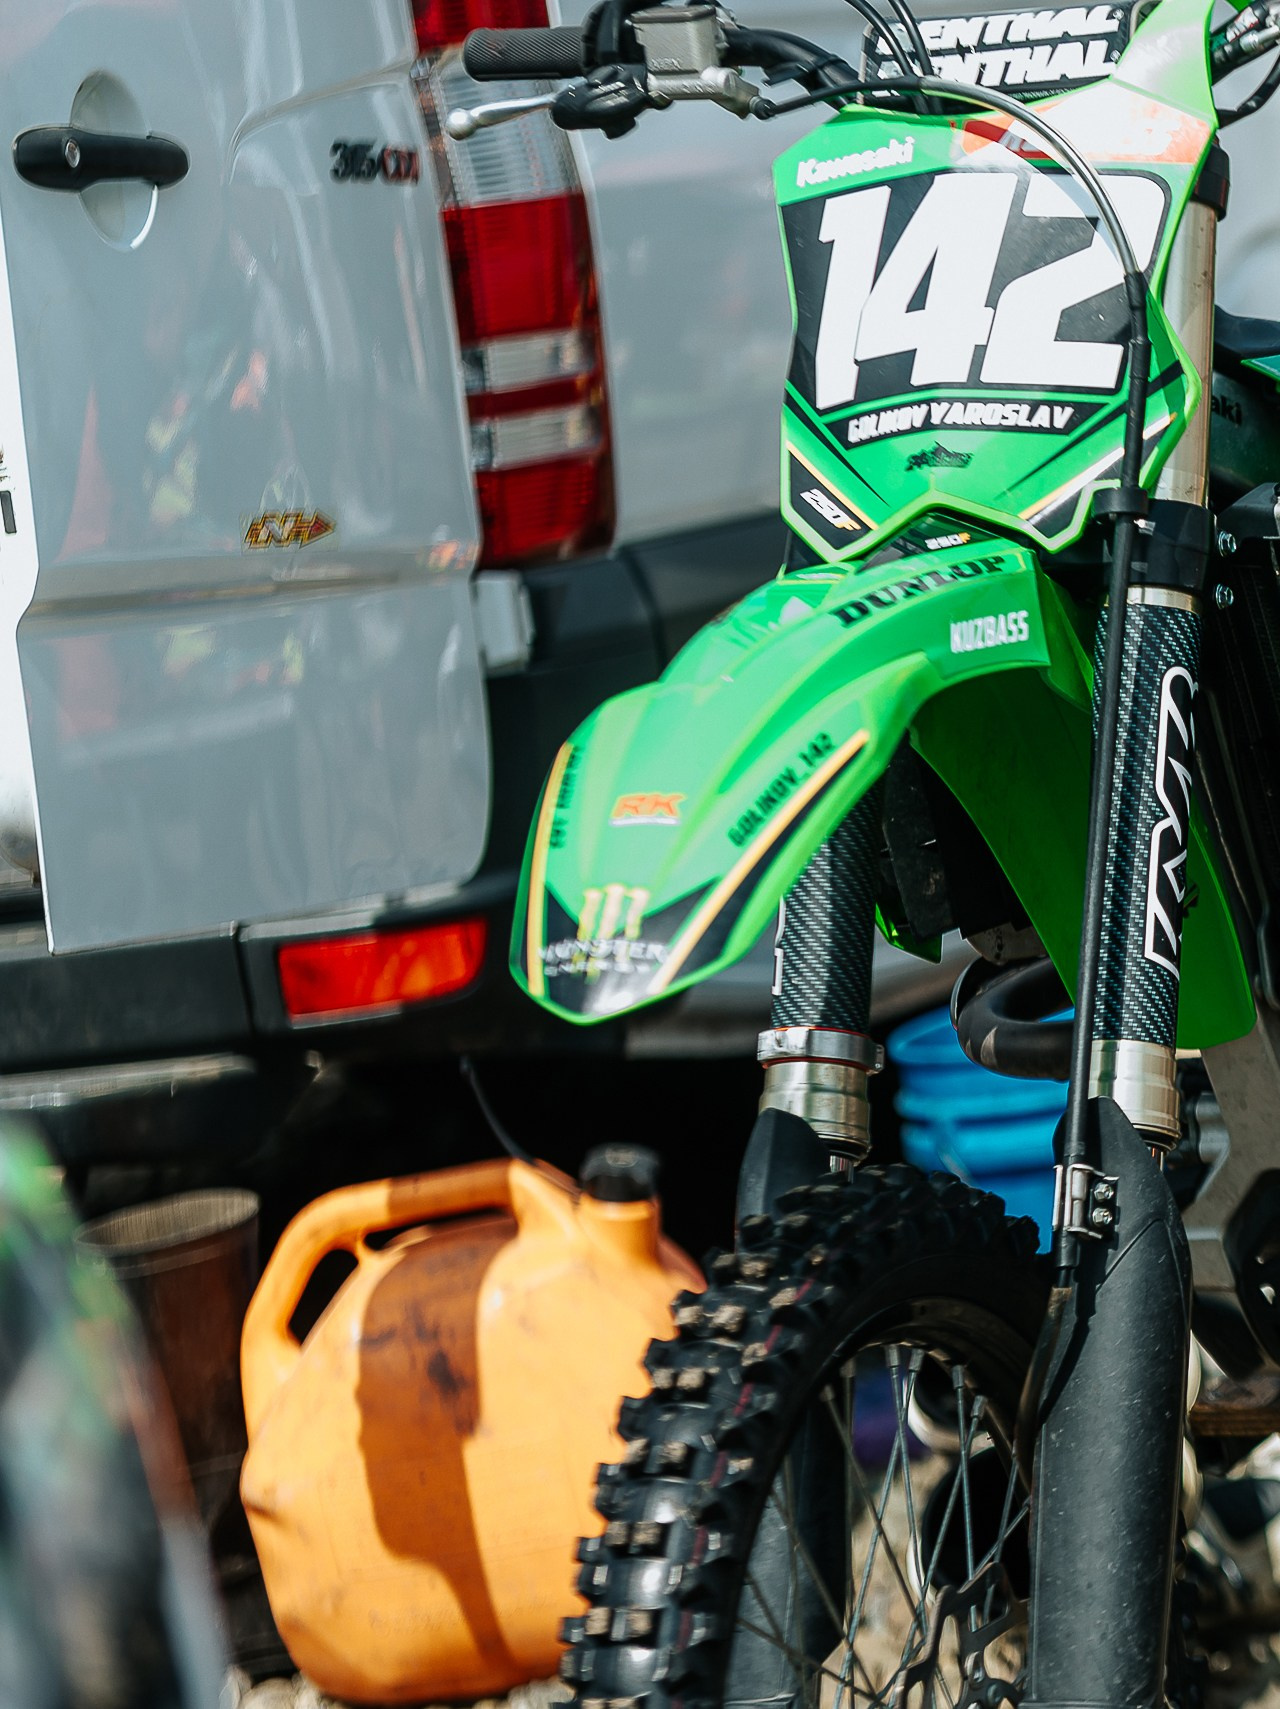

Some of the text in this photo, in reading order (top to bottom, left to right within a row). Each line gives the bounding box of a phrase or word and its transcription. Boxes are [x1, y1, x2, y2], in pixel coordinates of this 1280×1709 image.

[796, 137, 914, 187] Kawasaki
[815, 172, 1164, 410] 142
[930, 402, 1074, 429] YAROSLAV
[834, 555, 1005, 627] DUNLOP
[950, 610, 1029, 654] KUZBASS
[611, 793, 686, 819] RK
